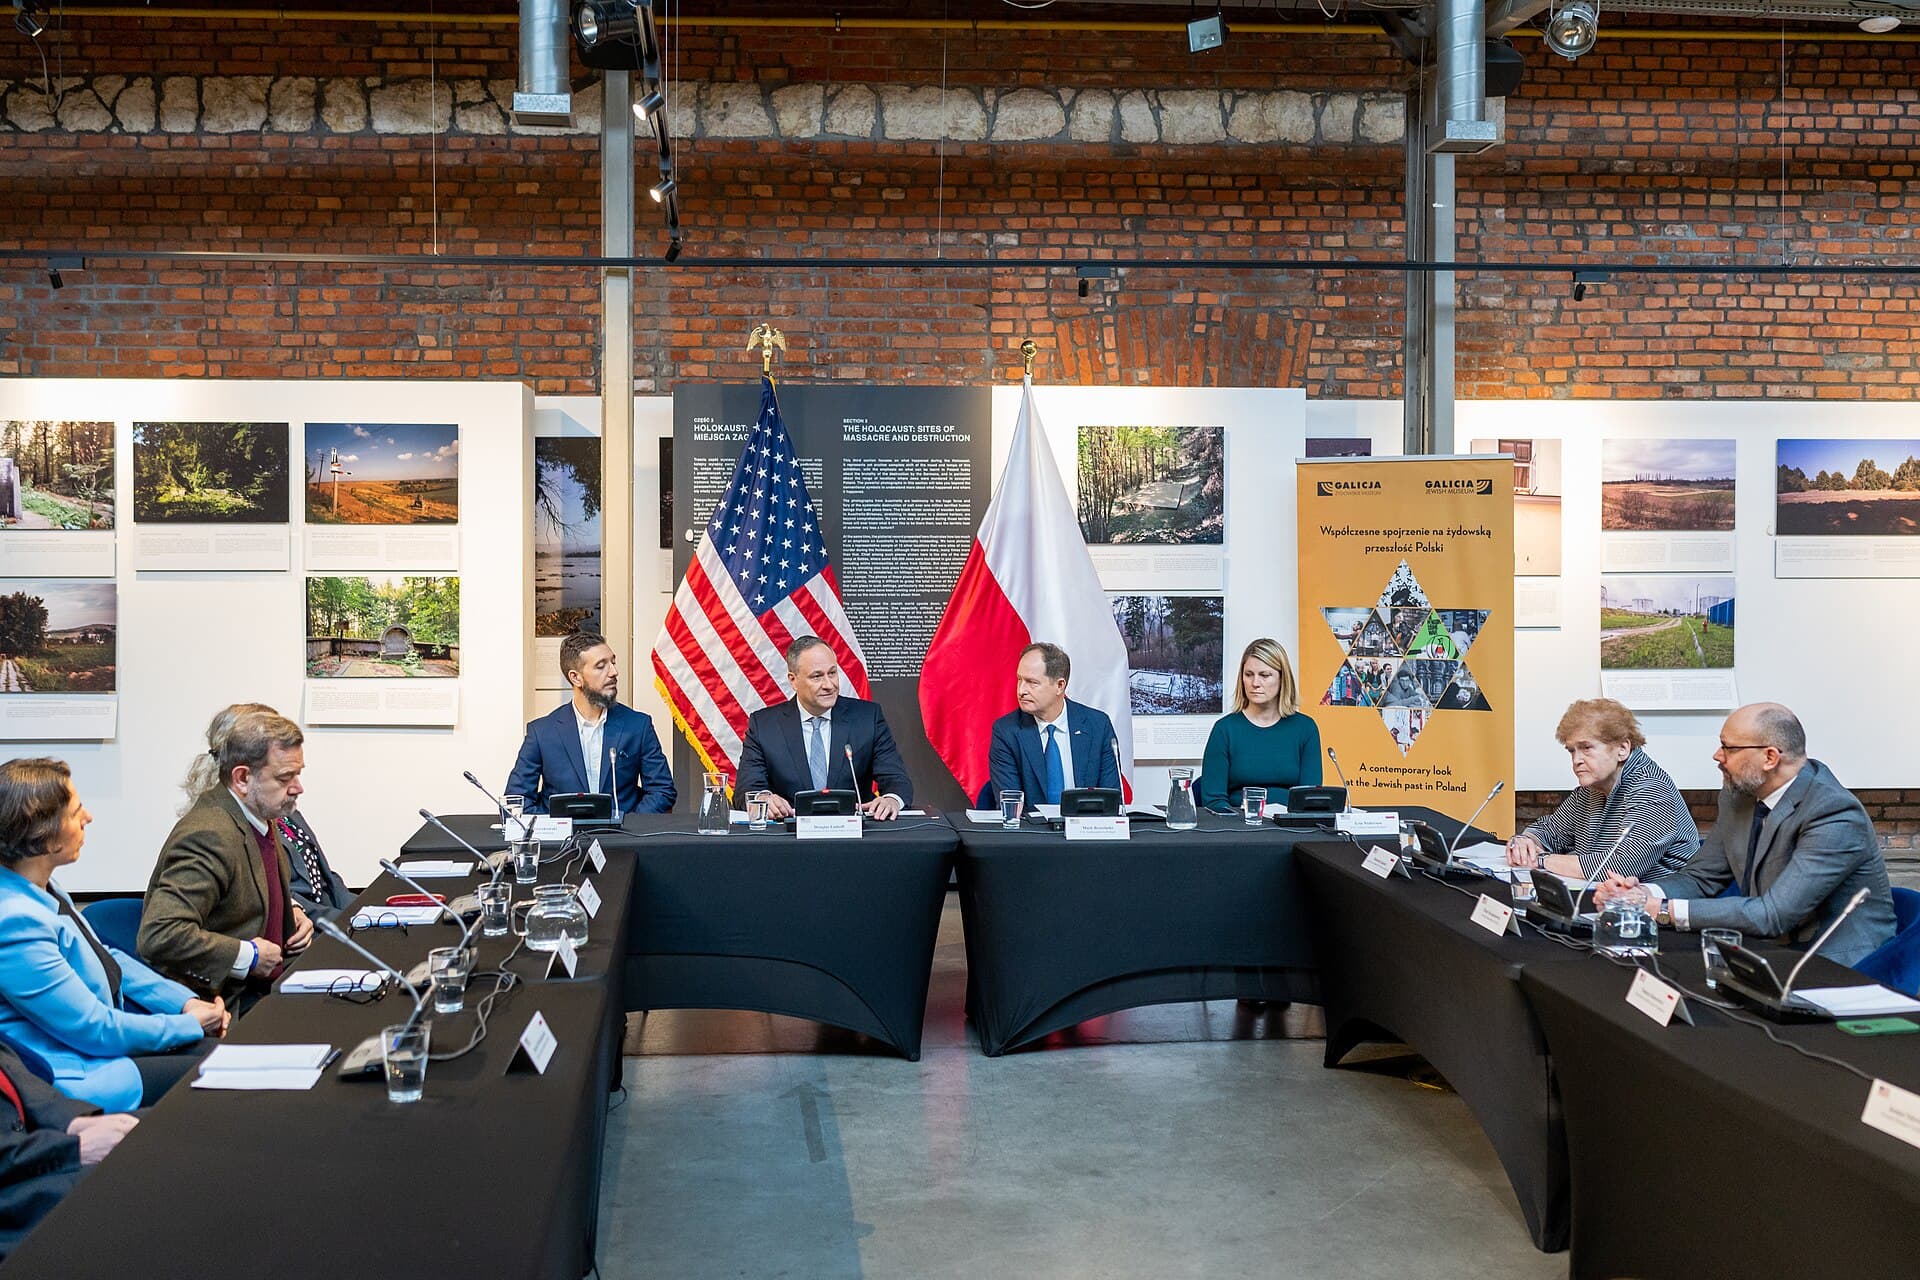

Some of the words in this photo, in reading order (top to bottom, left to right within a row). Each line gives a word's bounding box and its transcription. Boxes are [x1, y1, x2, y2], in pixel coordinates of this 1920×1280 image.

[693, 424, 749, 432] HOLOKAUST:
[843, 425, 860, 433] THE
[861, 425, 916, 433] HOLOCAUST:
[917, 425, 942, 433] SITES
[943, 425, 956, 433] OF
[693, 433, 731, 441] MIEJSCA
[843, 434, 890, 442] MASSACRE
[891, 434, 911, 442] AND
[912, 434, 971, 442] DESTRUCTION
[1334, 481, 1382, 490] GALICJA
[1424, 480, 1474, 488] GALICIA
[1320, 525, 1380, 539] Współczesne
[1382, 526, 1430, 539] spojrzenie
[1446, 525, 1492, 539] żydowską
[1365, 541, 1413, 555] przeszłość
[1415, 541, 1444, 553] Polski
[1359, 762, 1367, 772] A
[1369, 765, 1431, 777] contemporary
[1433, 764, 1452, 776] look
[1345, 778, 1354, 787] at
[1355, 776, 1370, 788] the
[1371, 777, 1403, 790] Jewish
[1404, 781, 1423, 792] past
[1425, 782, 1434, 791] in
[1435, 780, 1467, 793] Poland
